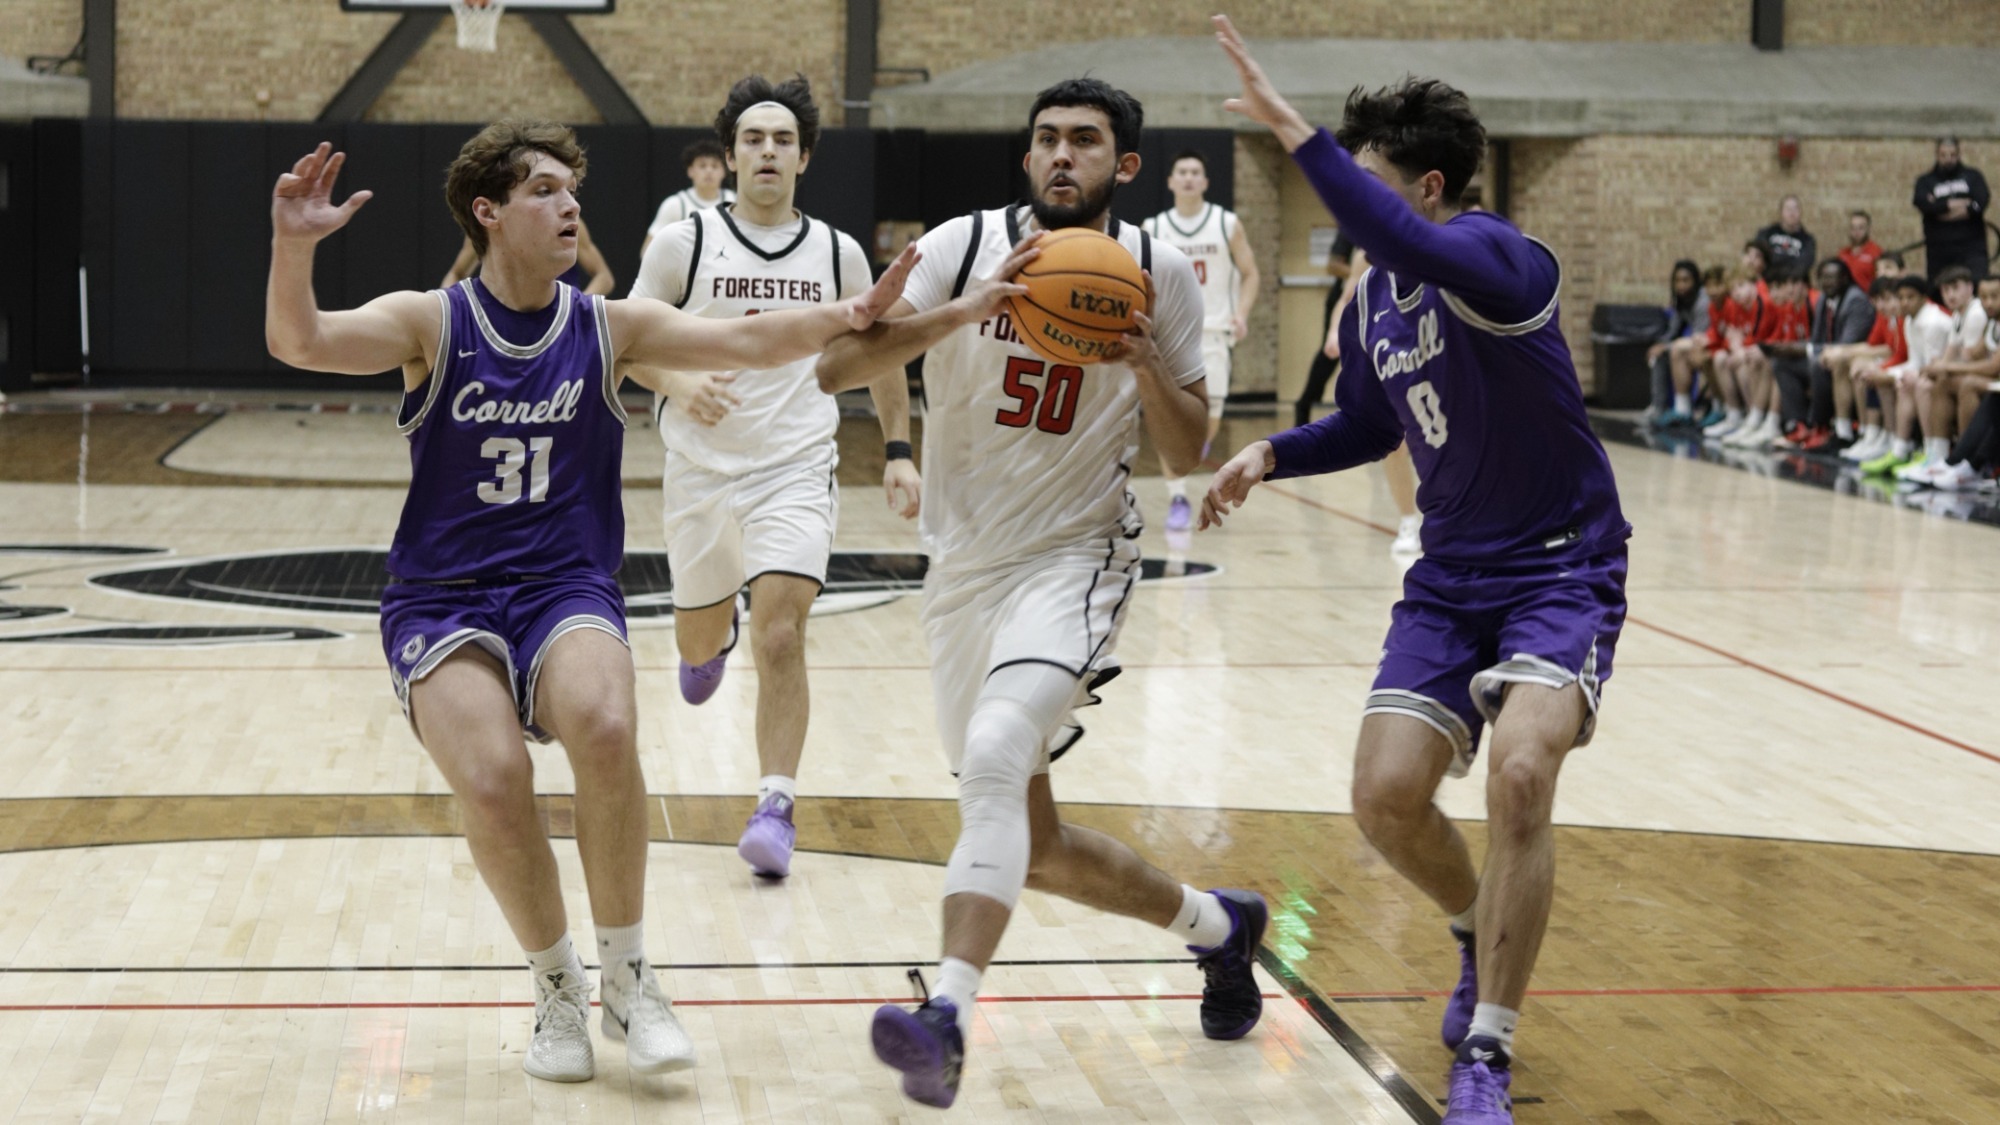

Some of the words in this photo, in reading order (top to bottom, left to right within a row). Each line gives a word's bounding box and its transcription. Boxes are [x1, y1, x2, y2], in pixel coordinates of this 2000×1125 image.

[713, 277, 821, 302] FORESTERS
[1070, 289, 1131, 319] NCAA
[1372, 308, 1445, 382] Cornell
[452, 378, 585, 424] Cornell
[995, 355, 1085, 435] 50
[1406, 380, 1449, 449] 0
[476, 436, 554, 504] 31
